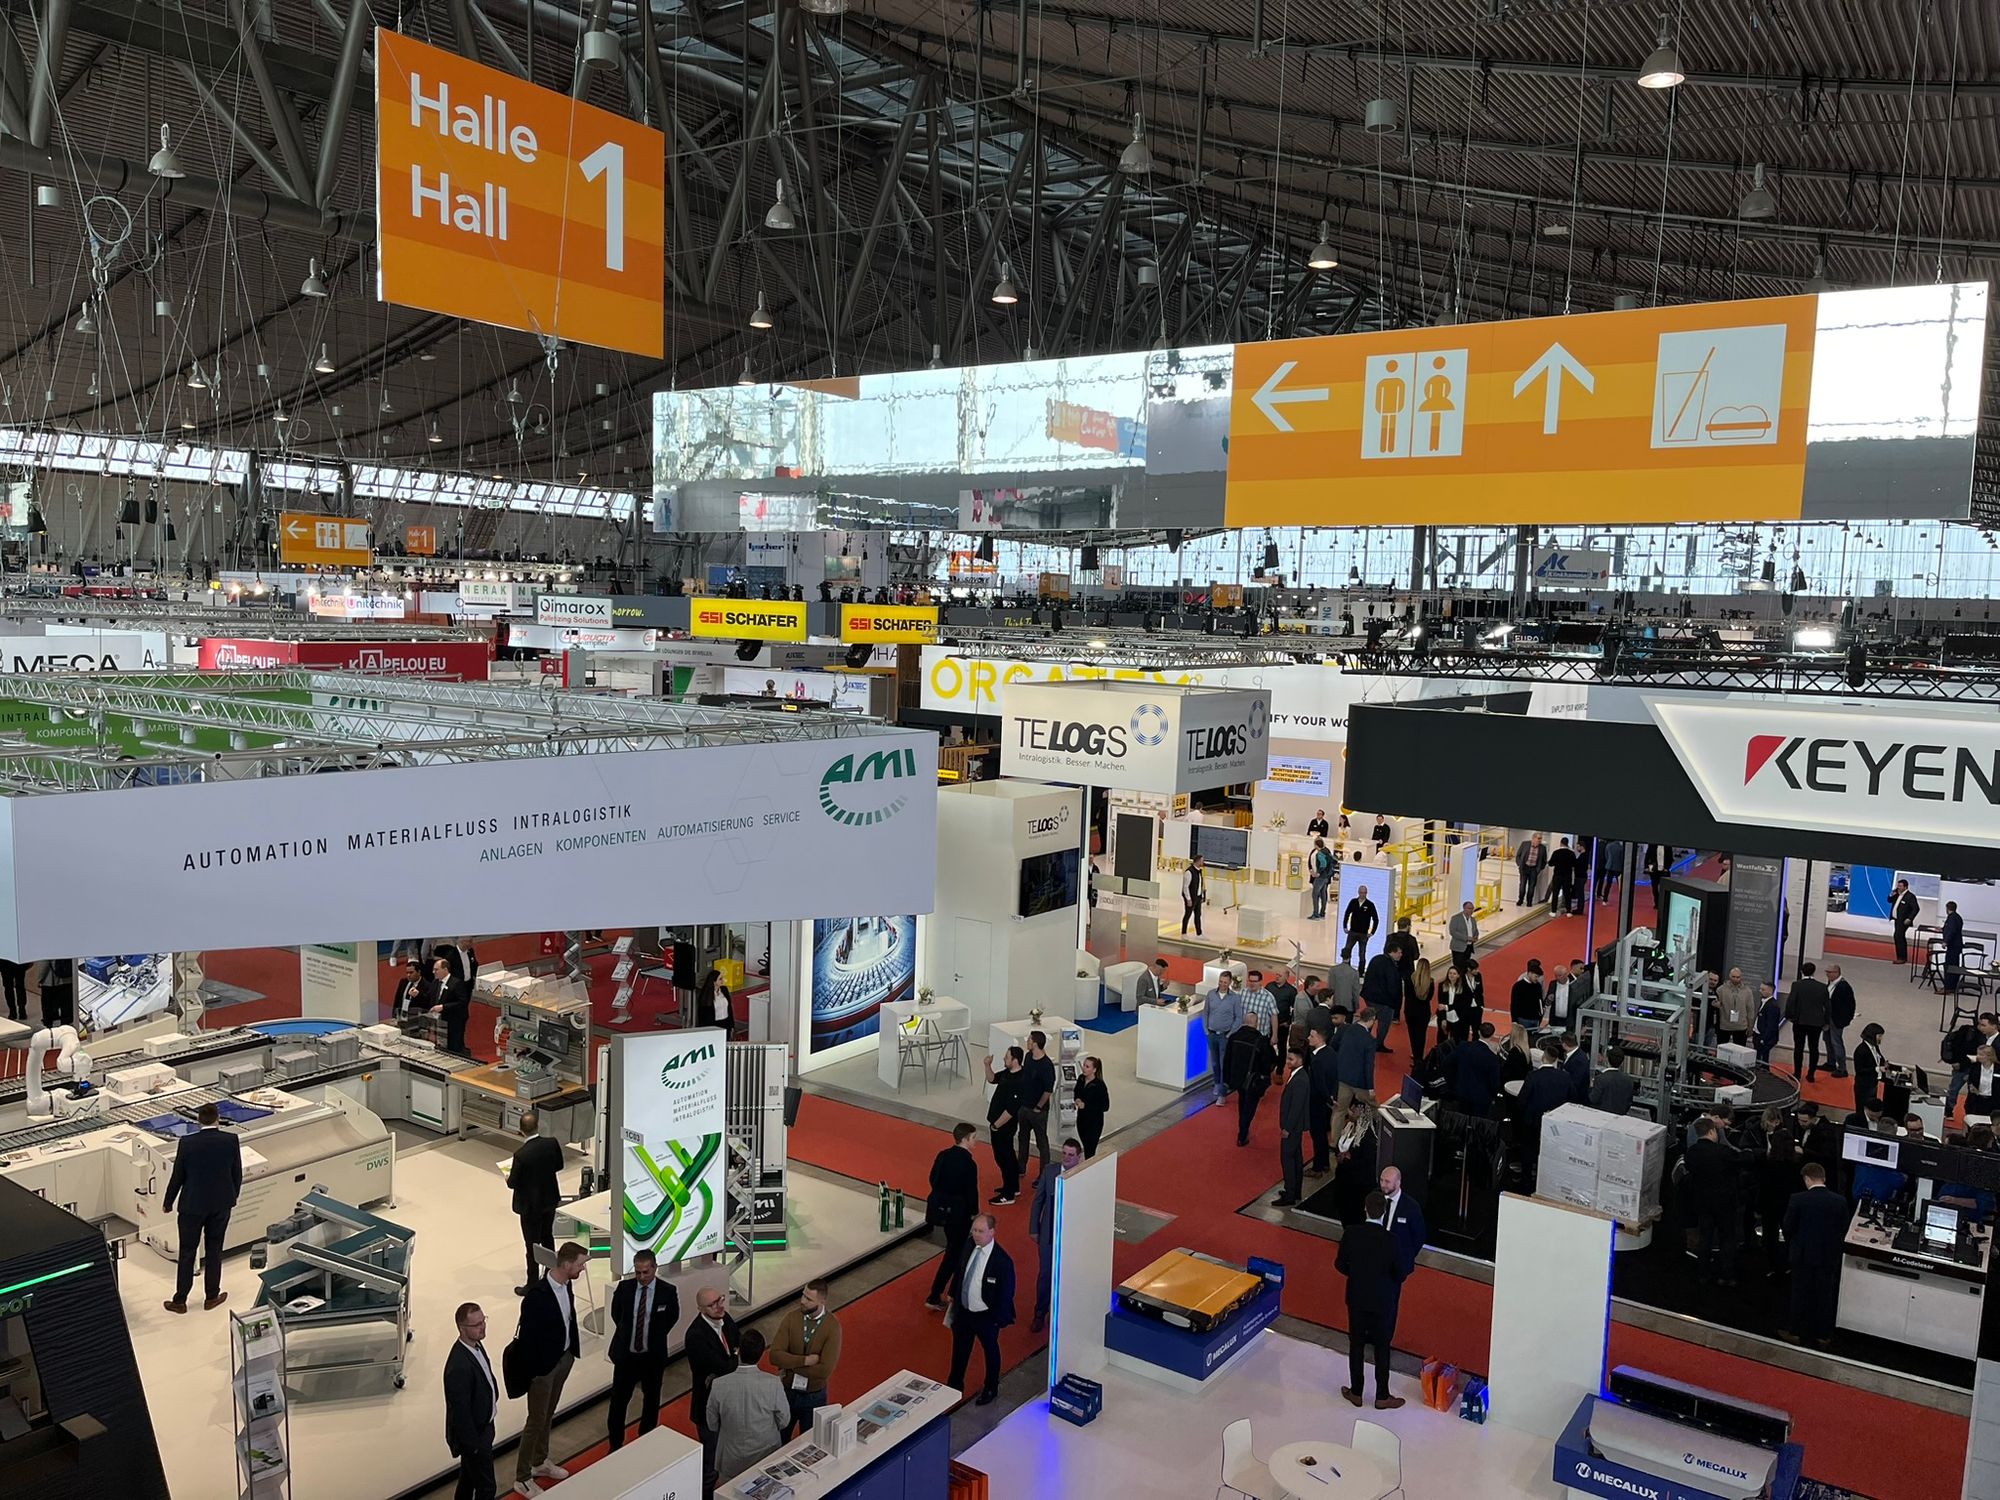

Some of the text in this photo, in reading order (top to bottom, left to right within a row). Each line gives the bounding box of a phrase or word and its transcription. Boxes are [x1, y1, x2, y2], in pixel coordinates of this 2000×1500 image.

[411, 72, 538, 163] Halle
[411, 164, 508, 240] Hall
[579, 141, 624, 270] 1
[464, 585, 507, 595] NERAK
[540, 599, 605, 615] Qimarox
[540, 614, 609, 625] Palletizing Solutions
[725, 612, 798, 627] SCHÄFER
[1293, 716, 1327, 727] YOUR
[1014, 716, 1128, 758] TELOGS
[1186, 724, 1248, 762] TELOGS
[822, 746, 917, 782] AMI
[1094, 760, 1127, 772] Machen.
[1744, 734, 2000, 807] KEYEN
[1027, 815, 1059, 834] TELOGS
[183, 804, 632, 872] AUTOMATION MATERIALFLUSS INTRALOGISTIK
[479, 811, 801, 863] ANLAGEN KOMPONENTEN AUTOMATISIERUNG SERVICE
[661, 1043, 716, 1073] AMI
[673, 1089, 709, 1106] AUTOMATION
[673, 1094, 718, 1115] MATERIALFLUSS
[673, 1104, 715, 1124] INTRALOGISTIK
[366, 1156, 390, 1171] DWS
[1568, 1155, 1596, 1168] KEYENCE
[1696, 1458, 1748, 1480] MECALUX
[1592, 1470, 1660, 1500] MECALUX
